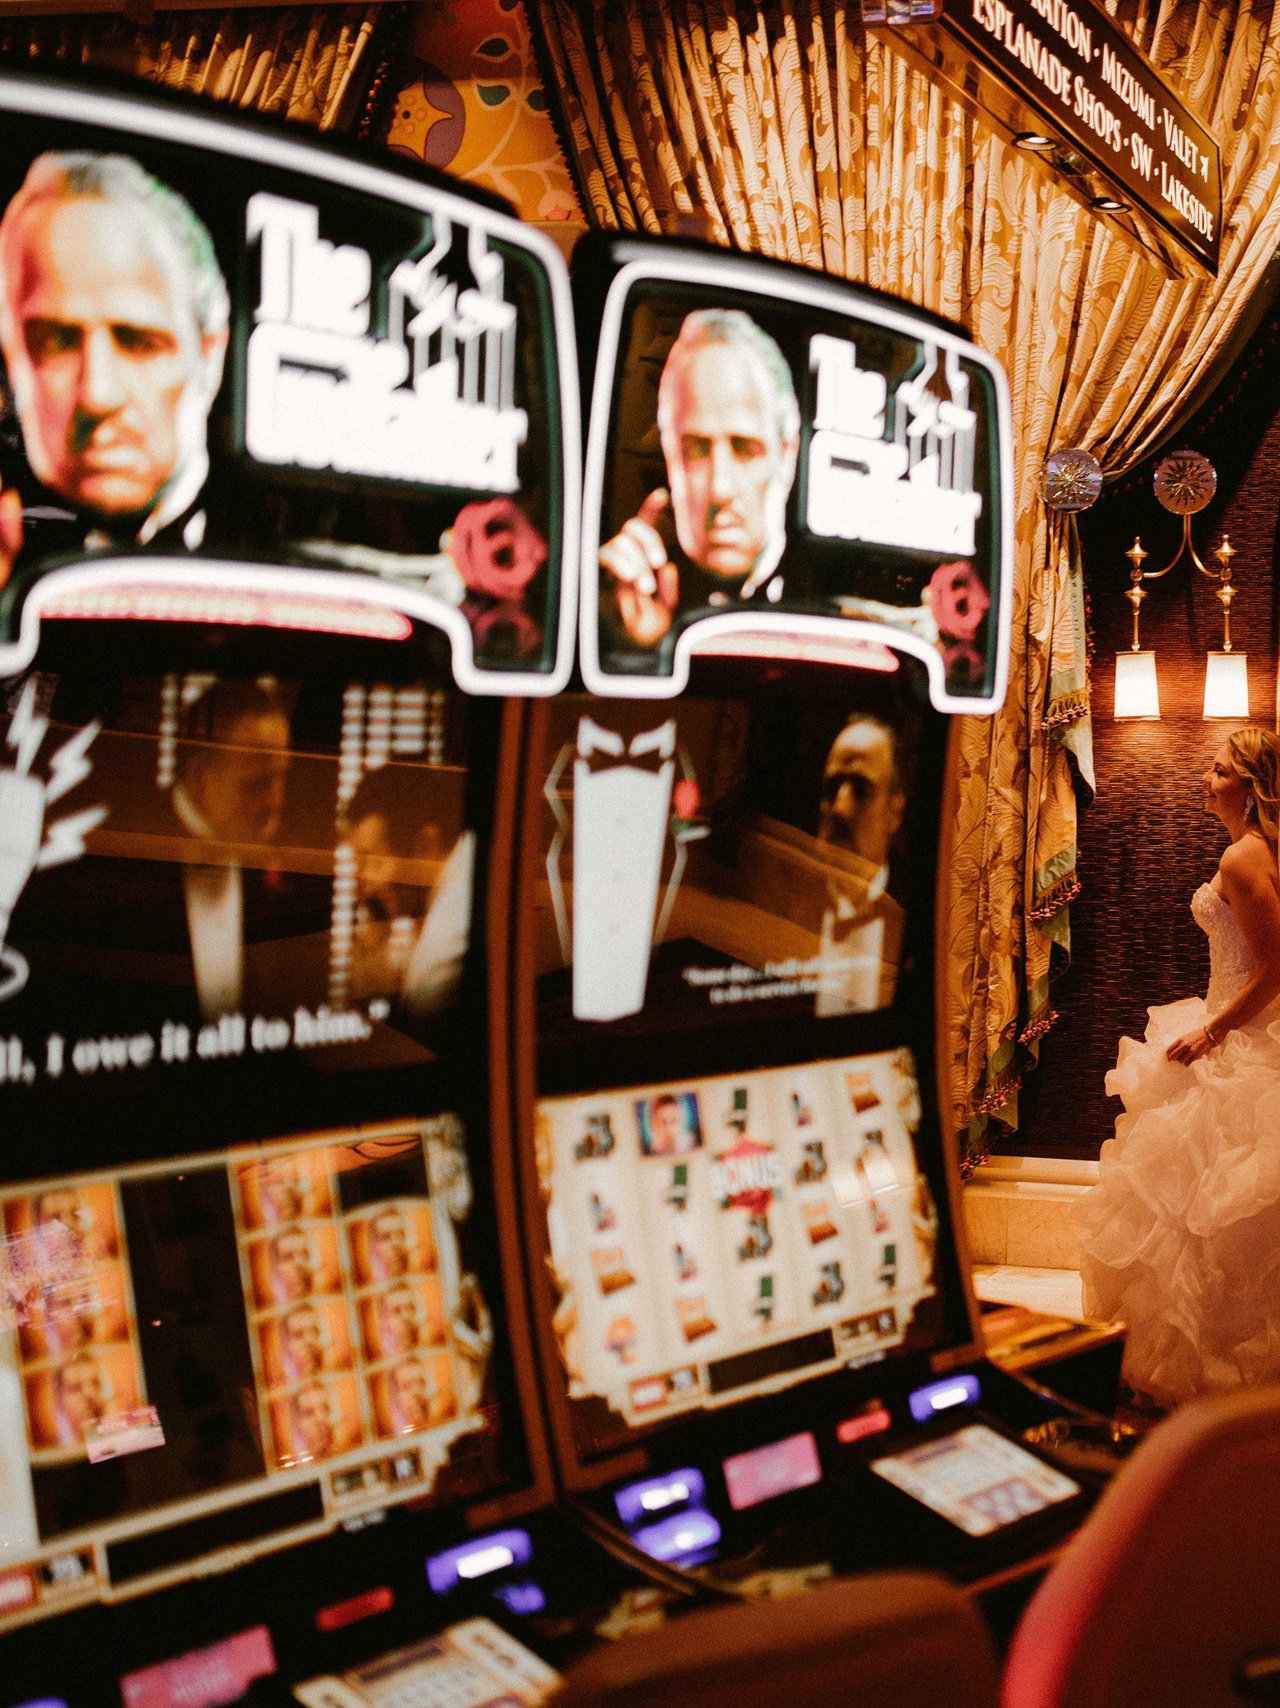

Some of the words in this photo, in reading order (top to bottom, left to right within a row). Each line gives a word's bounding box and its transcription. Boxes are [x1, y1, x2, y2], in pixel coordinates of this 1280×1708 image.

[1073, 75, 1122, 152] SHOPS
[1131, 132, 1153, 182] SW
[1161, 160, 1213, 242] LAKESIDE
[1101, 42, 1155, 131] MIZUMI
[1163, 107, 1199, 175] VALET
[72, 1031, 155, 1073] owe
[160, 1018, 190, 1064] it
[196, 1011, 246, 1059] all
[250, 1013, 290, 1053] to
